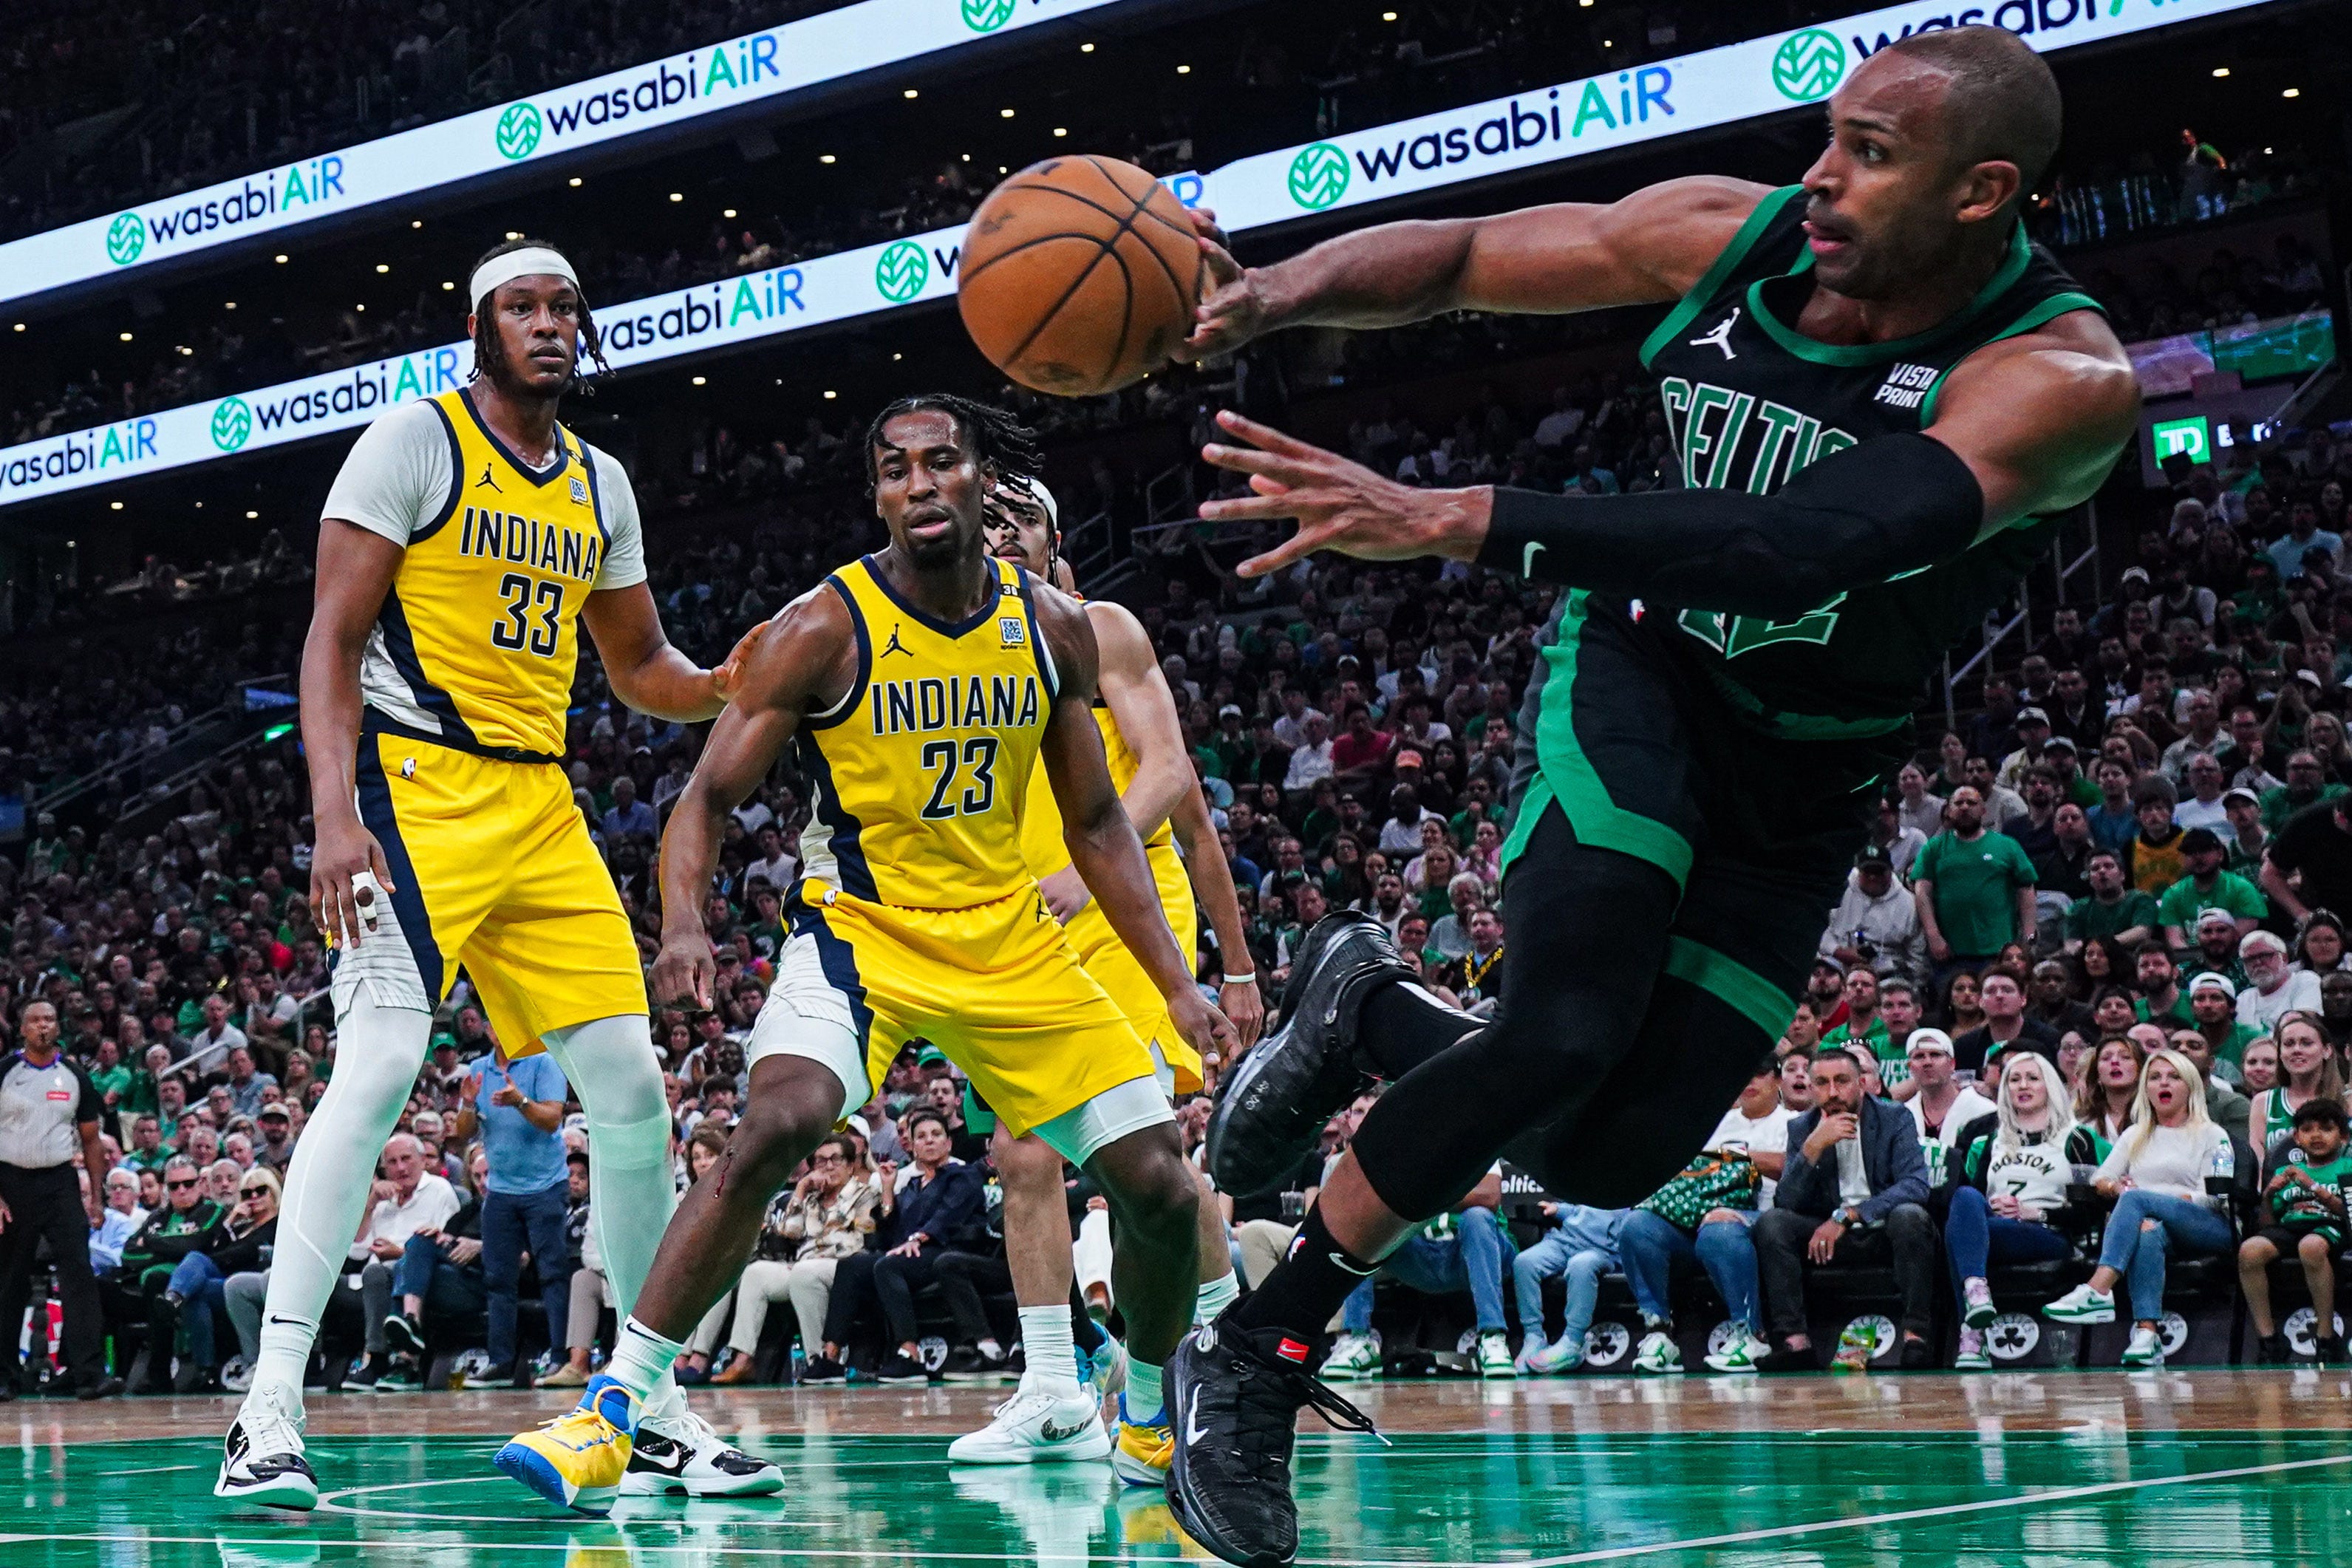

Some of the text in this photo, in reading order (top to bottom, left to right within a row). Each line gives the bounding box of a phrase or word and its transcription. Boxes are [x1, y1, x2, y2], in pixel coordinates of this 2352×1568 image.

[547, 54, 697, 135] wasabi
[1356, 89, 1561, 182] wasabi
[150, 171, 275, 243] wasabi
[256, 363, 387, 431] wasabi
[1873, 384, 1926, 409] PRINT
[1886, 362, 1939, 390] VISTA
[2158, 426, 2203, 456] TD
[459, 505, 600, 584] INDIANA
[490, 571, 565, 659] 33
[870, 675, 1039, 737] INDIANA
[920, 737, 1000, 822] 23
[1991, 1152, 2056, 1176] BOSTON
